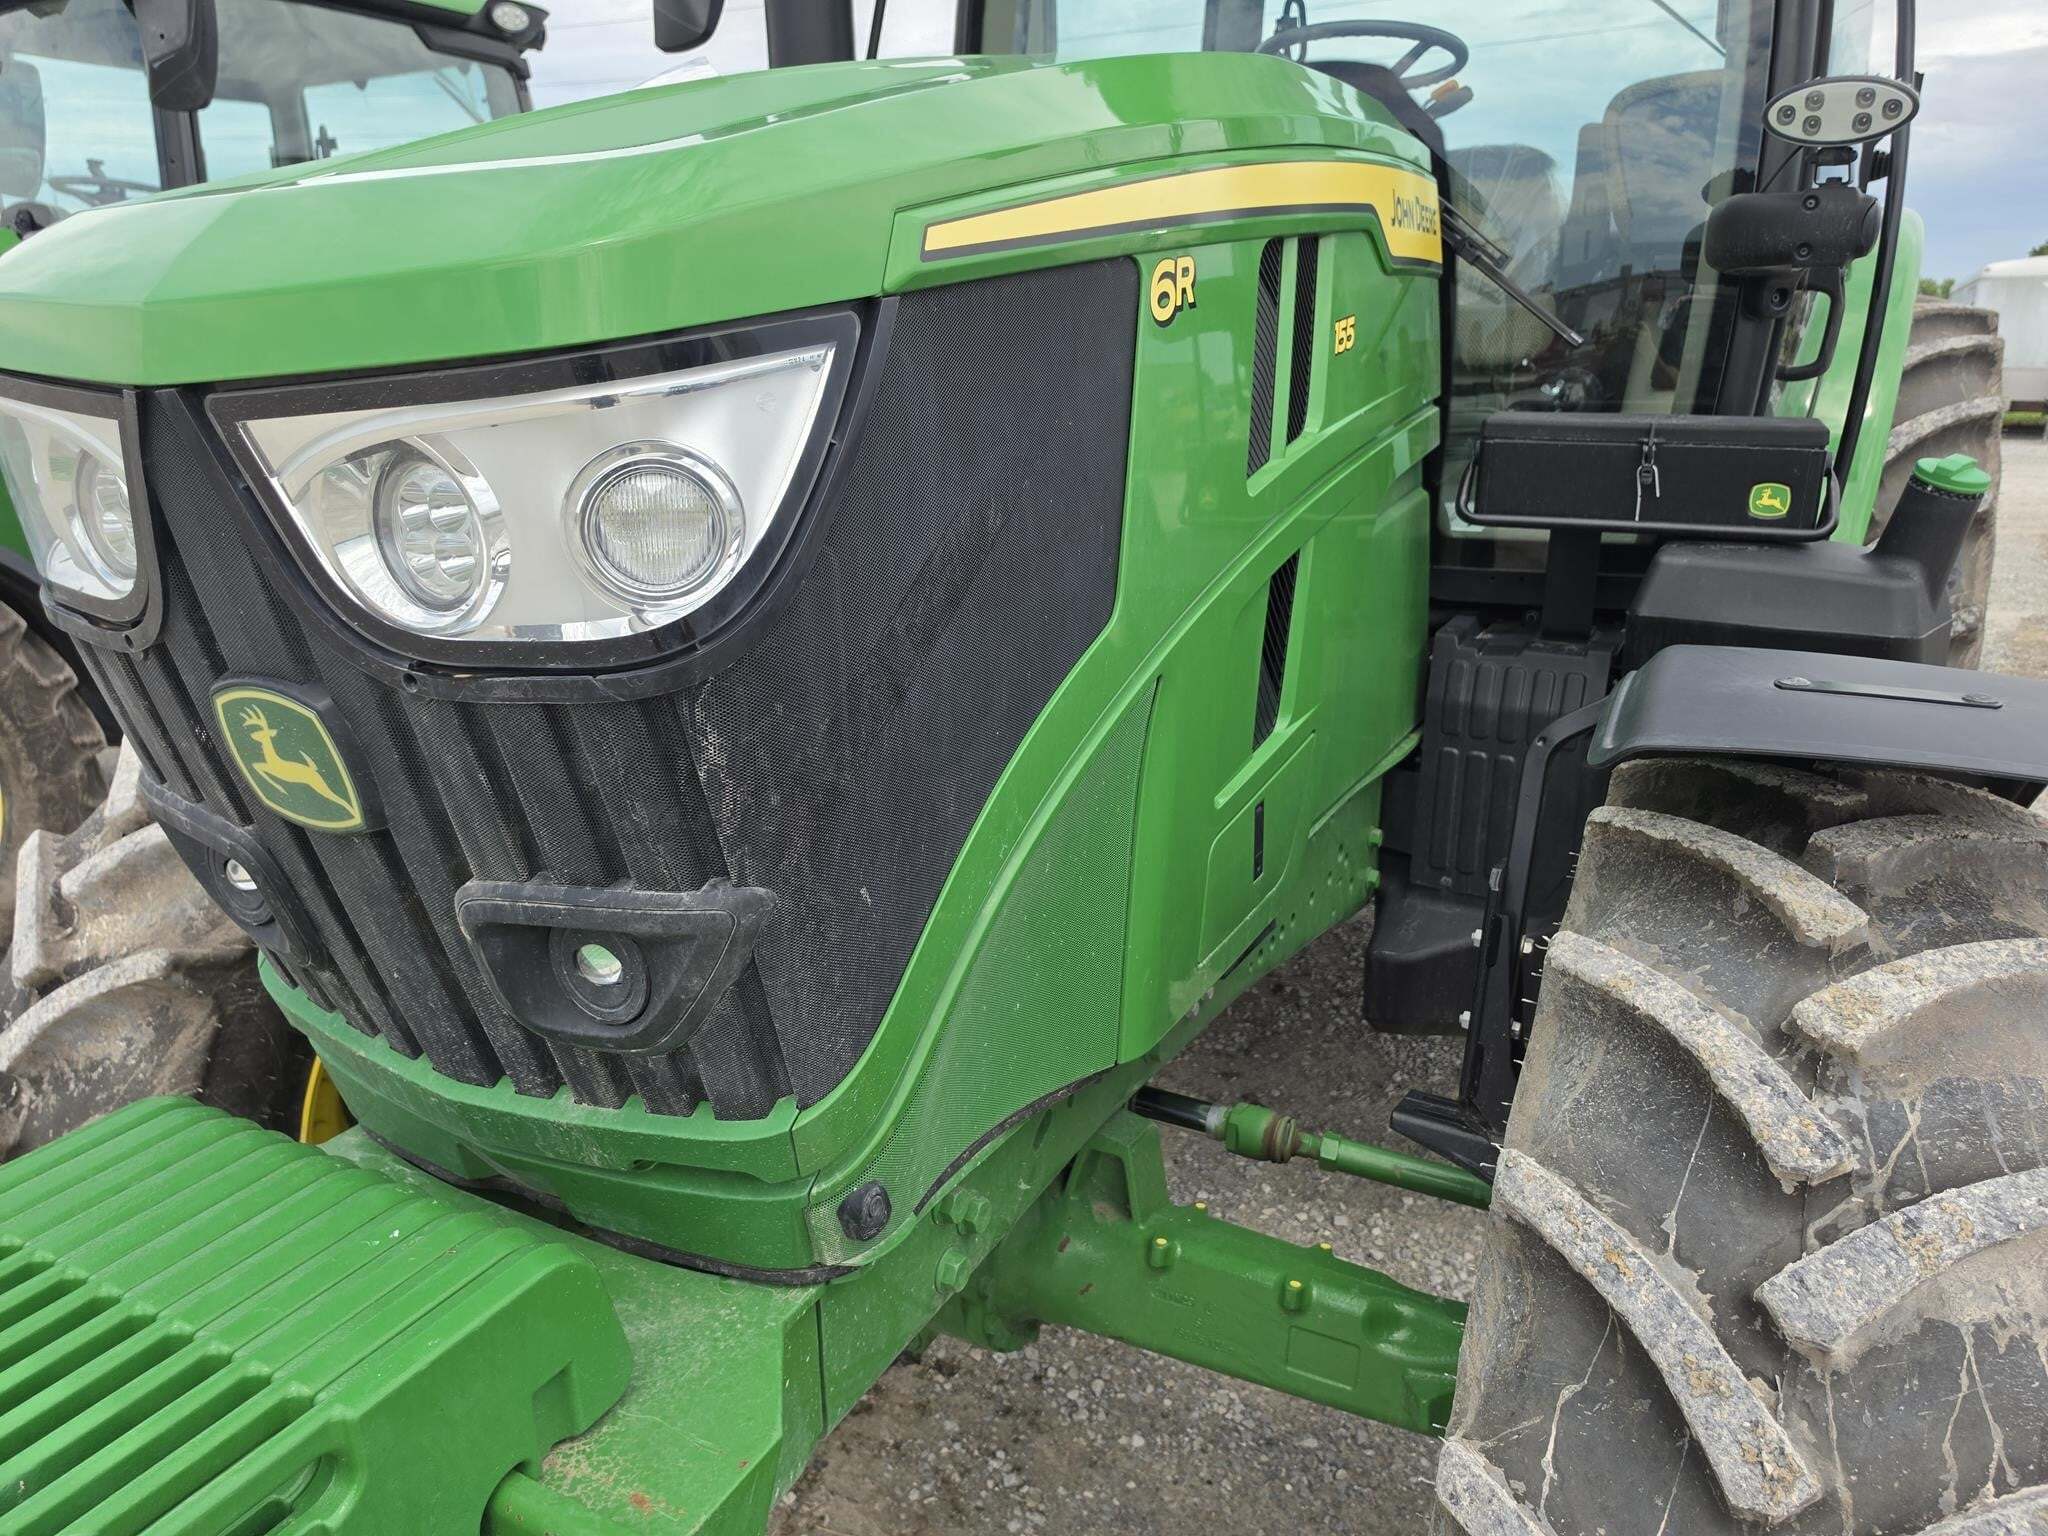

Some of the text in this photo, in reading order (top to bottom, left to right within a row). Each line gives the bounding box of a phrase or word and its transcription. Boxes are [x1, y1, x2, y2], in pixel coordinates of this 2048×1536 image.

[1390, 187, 1437, 236] JOHN DEERE
[1150, 254, 1196, 326] 6R
[1334, 313, 1356, 356] 155
